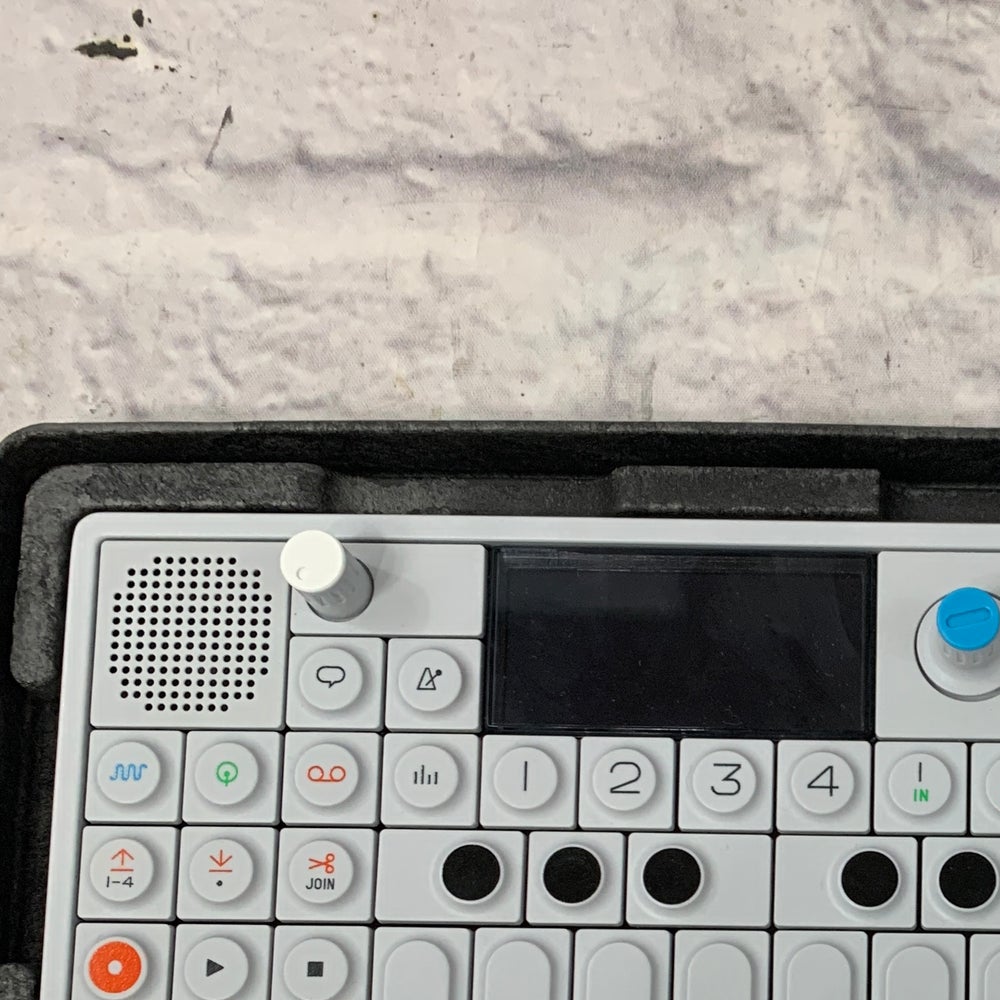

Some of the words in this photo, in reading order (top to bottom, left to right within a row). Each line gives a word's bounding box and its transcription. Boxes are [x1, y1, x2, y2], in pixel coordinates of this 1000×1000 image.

[610, 762, 641, 794] 2
[711, 763, 741, 796] 3
[807, 766, 839, 796] 4
[913, 789, 928, 802] IN
[305, 878, 334, 890] JOIN
